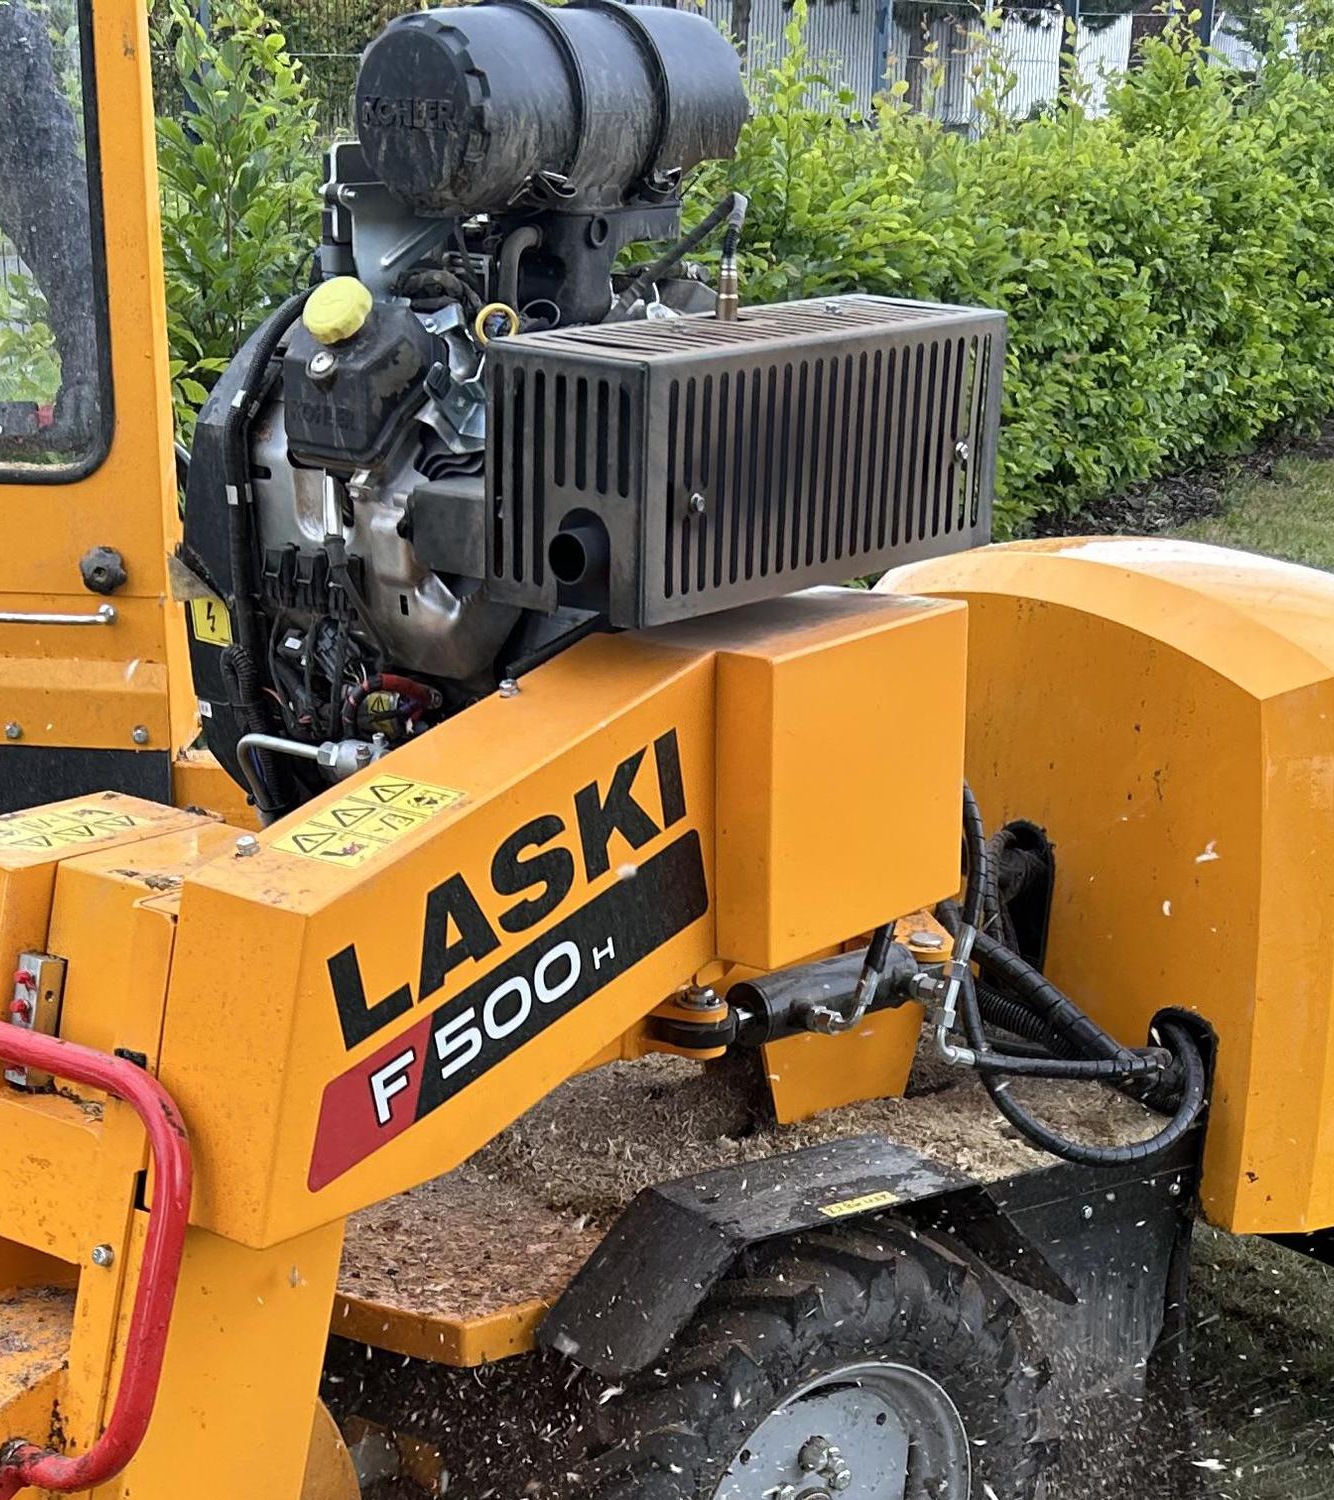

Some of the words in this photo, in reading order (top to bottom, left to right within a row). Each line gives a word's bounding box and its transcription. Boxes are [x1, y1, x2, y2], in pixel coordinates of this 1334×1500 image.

[361, 96, 458, 132] KOHLER
[327, 727, 687, 1051] LASKI
[370, 1050, 415, 1126] F
[434, 940, 582, 1080] 500
[592, 937, 616, 970] H
